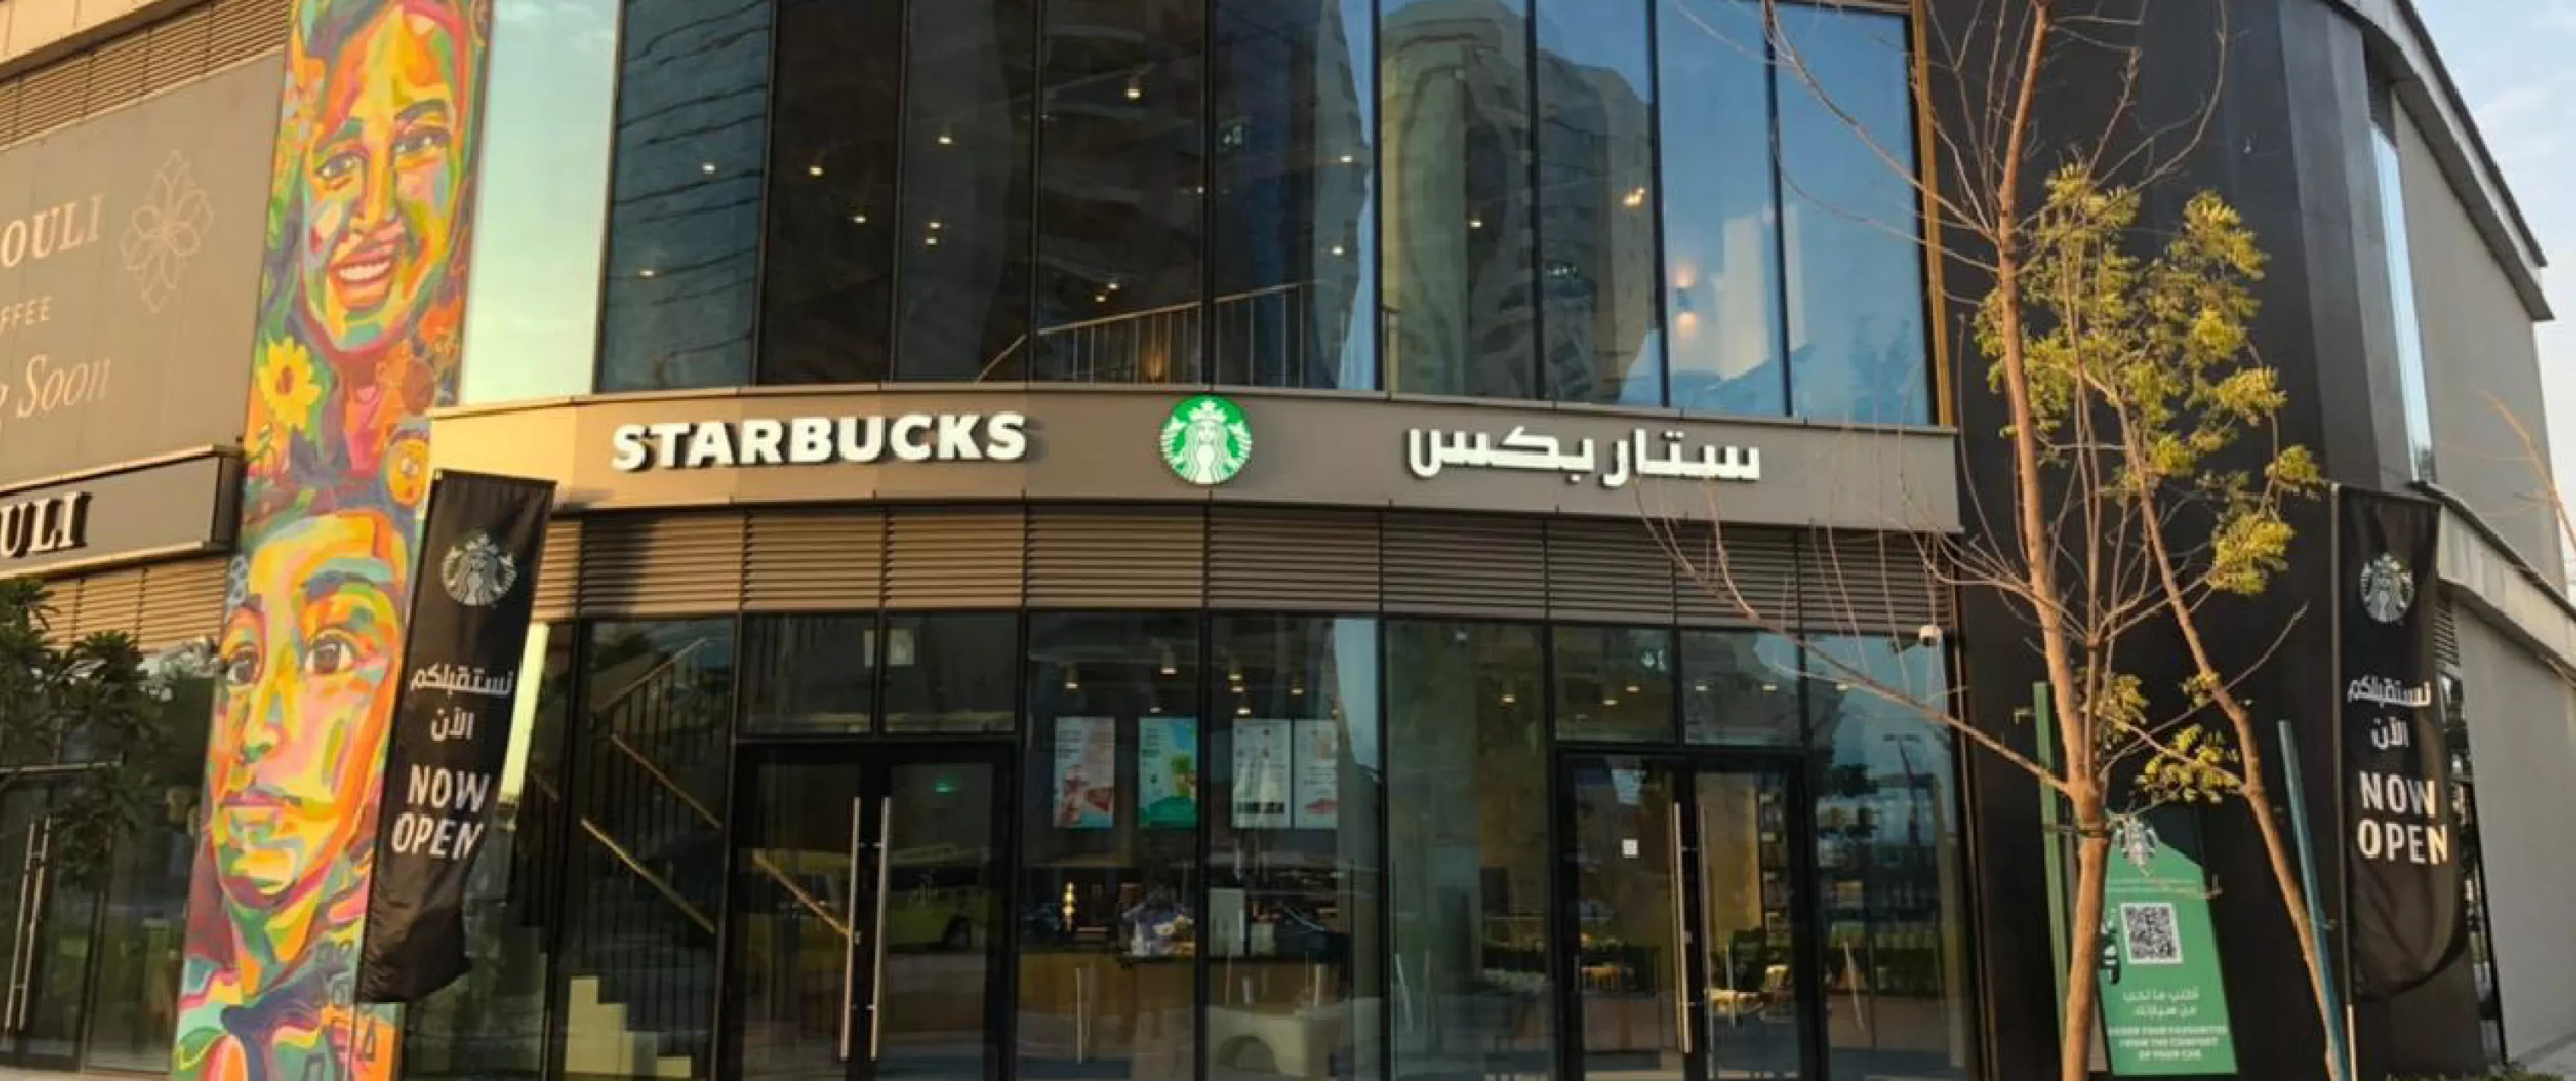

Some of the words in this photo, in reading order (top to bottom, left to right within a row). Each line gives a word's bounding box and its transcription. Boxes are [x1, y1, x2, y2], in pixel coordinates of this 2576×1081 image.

[2, 193, 106, 268] OULI
[612, 411, 1026, 470] STARBUCKS
[408, 764, 491, 813] NOW
[2359, 771, 2436, 818] NOW
[391, 811, 485, 859] OPEN
[2358, 819, 2448, 865] OPEN
